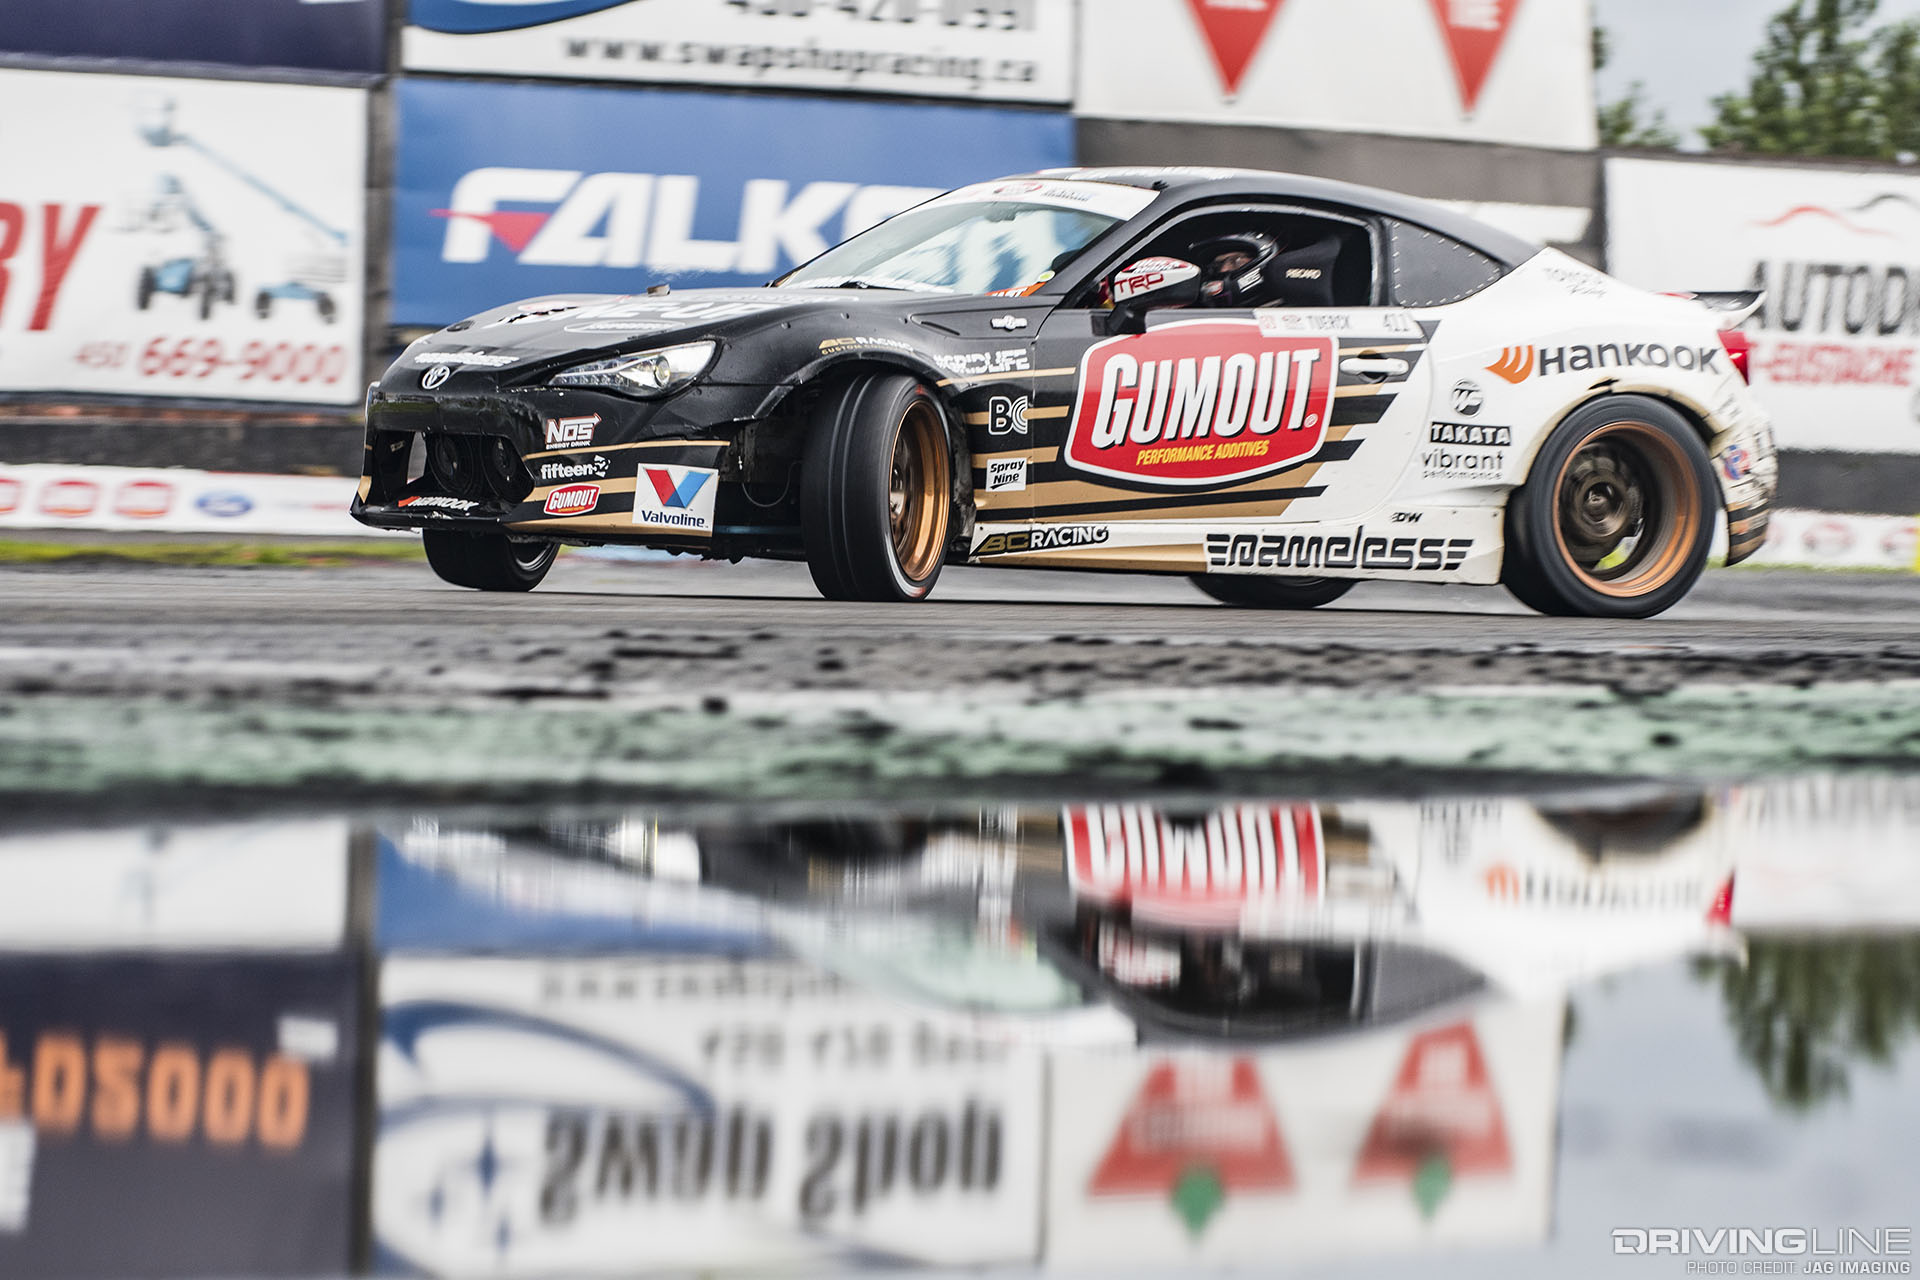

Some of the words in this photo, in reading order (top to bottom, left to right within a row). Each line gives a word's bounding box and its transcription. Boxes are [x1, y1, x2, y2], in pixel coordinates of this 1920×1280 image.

[1114, 271, 1165, 295] TRD
[1745, 261, 1920, 336] AUTOD
[139, 337, 345, 384] 669-9000
[1090, 348, 1320, 450] GUMOUT
[546, 413, 602, 444] NOS
[1431, 423, 1510, 444] TAKATA
[1136, 444, 1214, 466] PERFORMANCE
[1214, 440, 1269, 459] ADDITIVES
[1422, 448, 1504, 469] vibrant
[990, 459, 1025, 476] Spray
[993, 472, 1020, 485] Nine
[549, 489, 597, 510] GUMOUT
[641, 510, 706, 528] Valvoline
